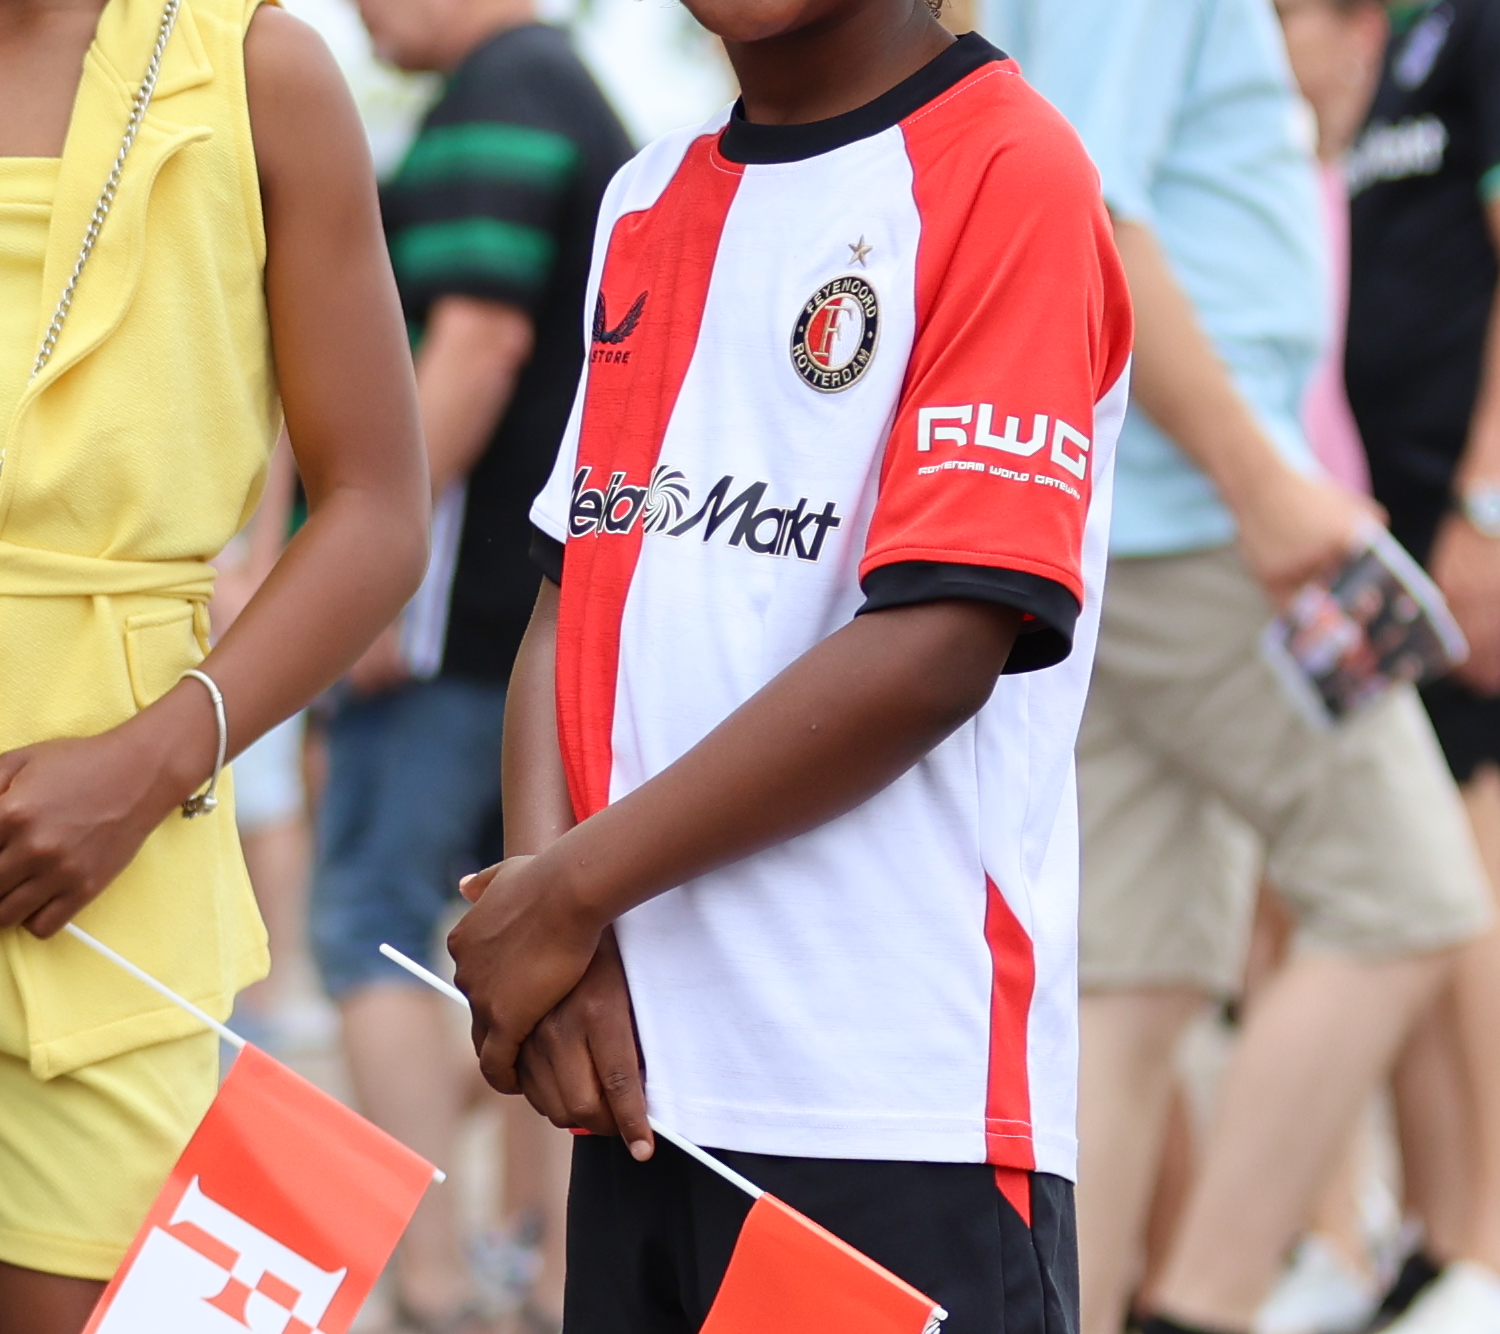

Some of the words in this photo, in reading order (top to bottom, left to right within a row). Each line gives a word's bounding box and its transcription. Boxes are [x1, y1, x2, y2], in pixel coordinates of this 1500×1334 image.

[807, 278, 877, 318] FEYENOORD
[813, 305, 854, 357] F
[793, 342, 870, 387] ROTTERDAM
[917, 403, 1090, 480] RWG
[918, 461, 985, 475] ROTTERDAM
[989, 465, 1030, 482] WORLD
